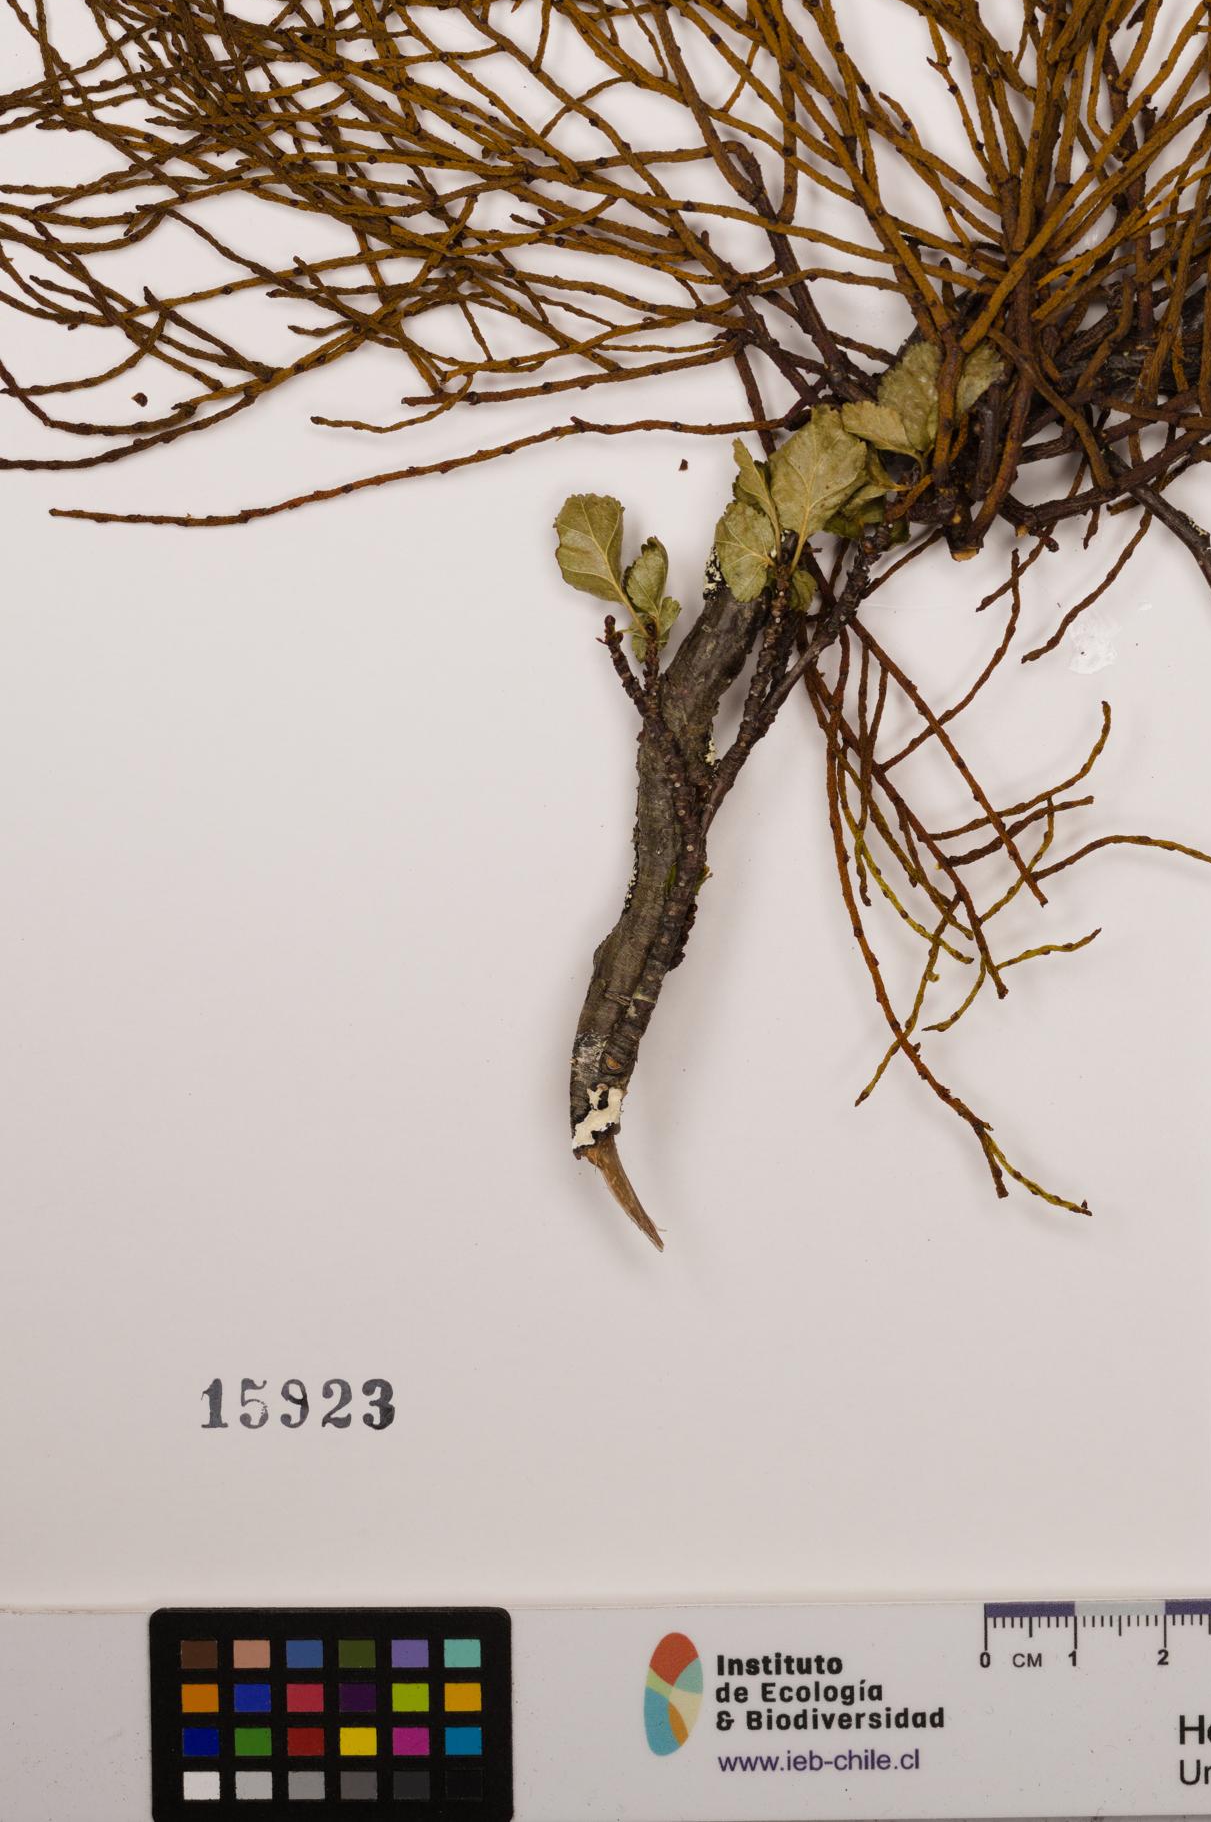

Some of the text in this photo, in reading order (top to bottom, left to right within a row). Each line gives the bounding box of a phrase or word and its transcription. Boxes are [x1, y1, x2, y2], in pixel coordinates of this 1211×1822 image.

[201, 1378, 396, 1431] 15923
[716, 1651, 843, 1677] Instituto
[979, 1651, 991, 1669] 0
[1012, 1652, 1043, 1668] CM
[1068, 1648, 1077, 1667] 1
[1157, 1648, 1169, 1666] 2
[715, 1679, 883, 1707] de Ecología
[715, 1706, 945, 1732] & Biodiversidad
[717, 1748, 920, 1772] www.ieb-chile.cl
